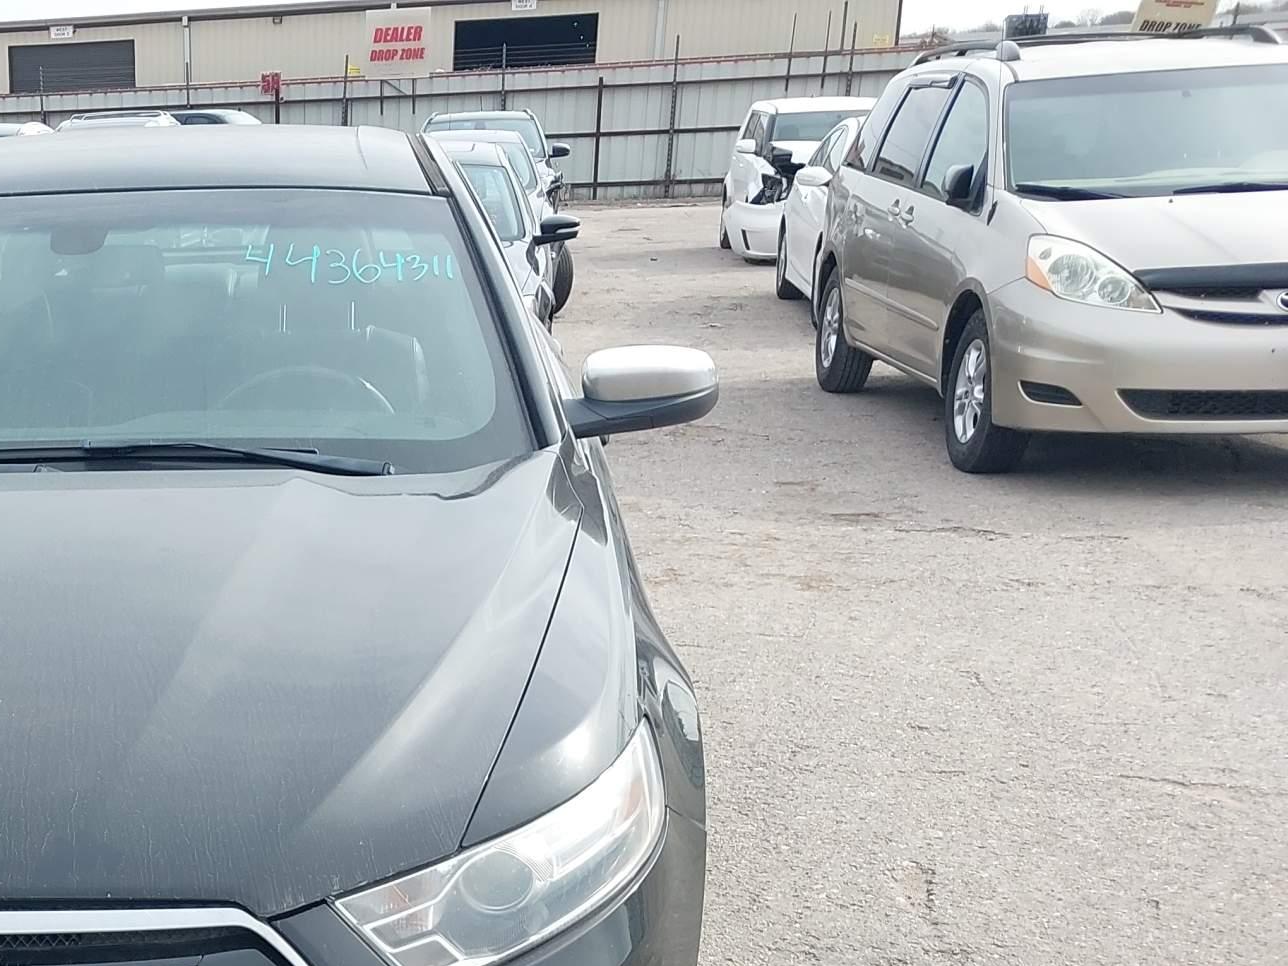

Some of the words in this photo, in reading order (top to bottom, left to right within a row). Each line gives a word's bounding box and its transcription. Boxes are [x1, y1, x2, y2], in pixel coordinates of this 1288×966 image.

[373, 25, 423, 44] DEALER
[1139, 20, 1172, 32] DROP
[369, 48, 398, 62] DROP
[399, 47, 426, 61] ZONE
[245, 242, 454, 285] 44364311
